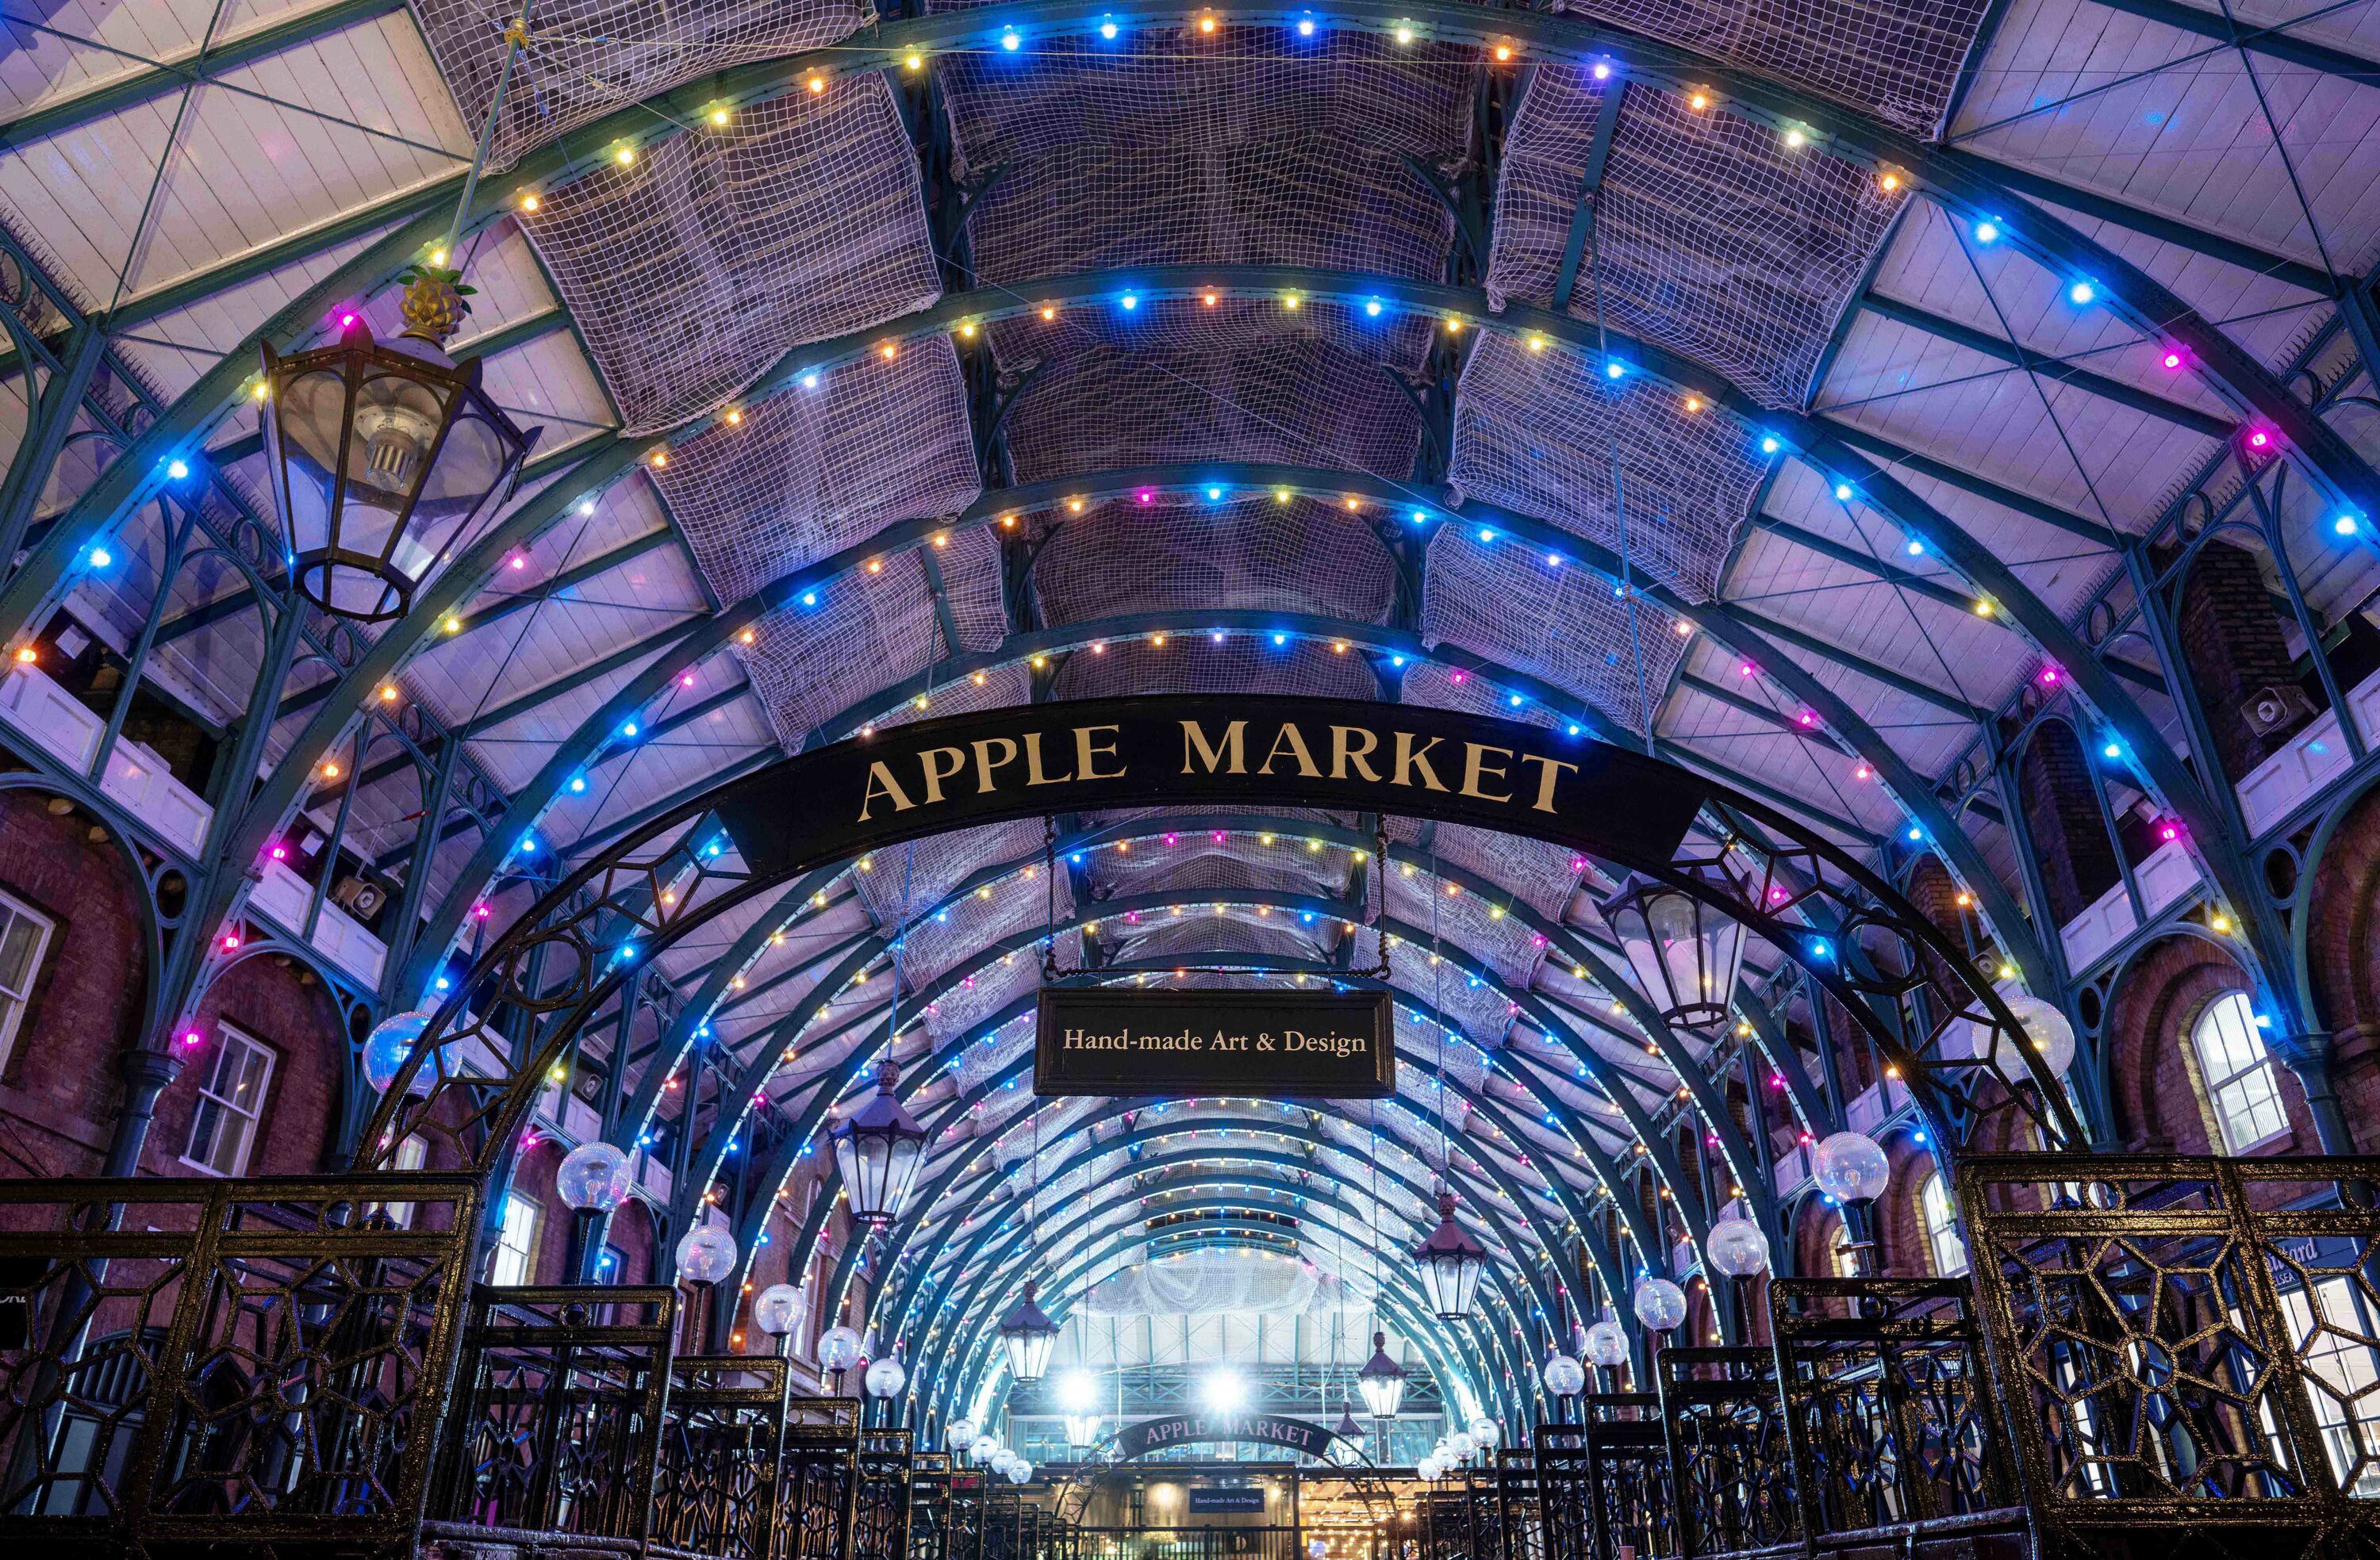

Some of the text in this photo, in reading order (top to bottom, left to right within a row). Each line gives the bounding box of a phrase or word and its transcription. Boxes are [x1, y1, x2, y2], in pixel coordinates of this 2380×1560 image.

[858, 719, 1579, 822] APPLE MARKET
[1062, 1028, 1367, 1058] Hand-made Art & Design
[1146, 1420, 1313, 1446] APPLE MARKET
[1241, 1497, 1259, 1505] Design
